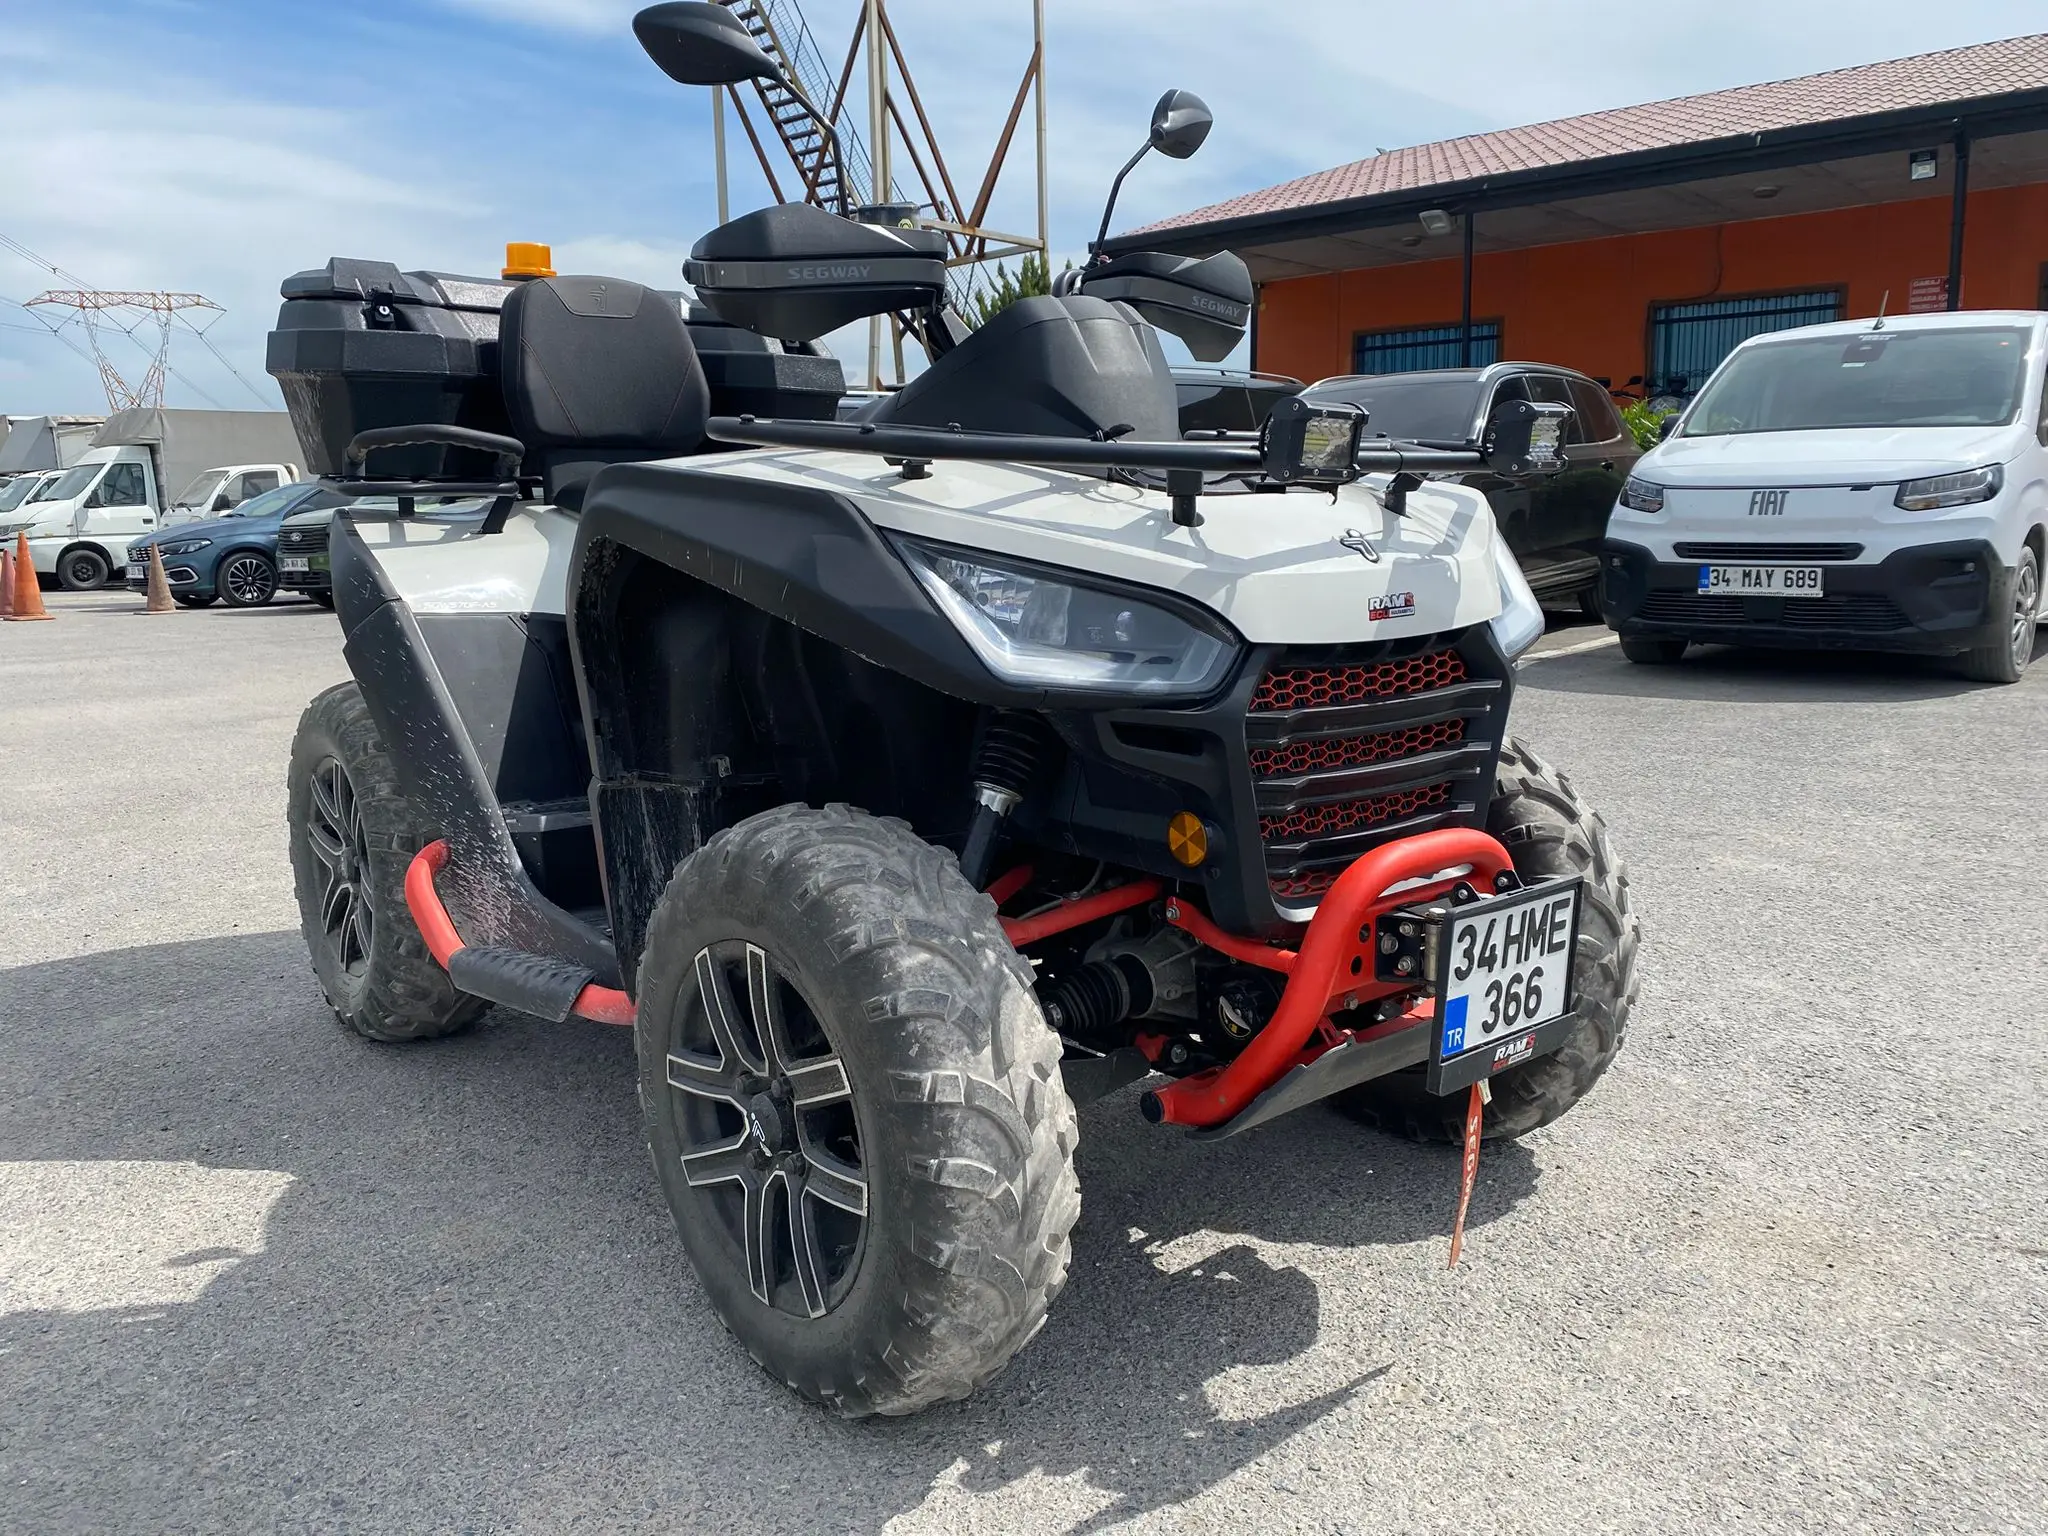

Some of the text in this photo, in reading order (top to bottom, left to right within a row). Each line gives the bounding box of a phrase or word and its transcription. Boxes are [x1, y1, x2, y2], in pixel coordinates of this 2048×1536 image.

[787, 265, 871, 280] SEGWAY
[1191, 295, 1240, 317] SEGWAY
[1748, 490, 1790, 516] FIAT
[1710, 568, 1819, 588] 34 MAY 689
[1481, 965, 1544, 1034] 366
[1447, 1027, 1462, 1048] TR
